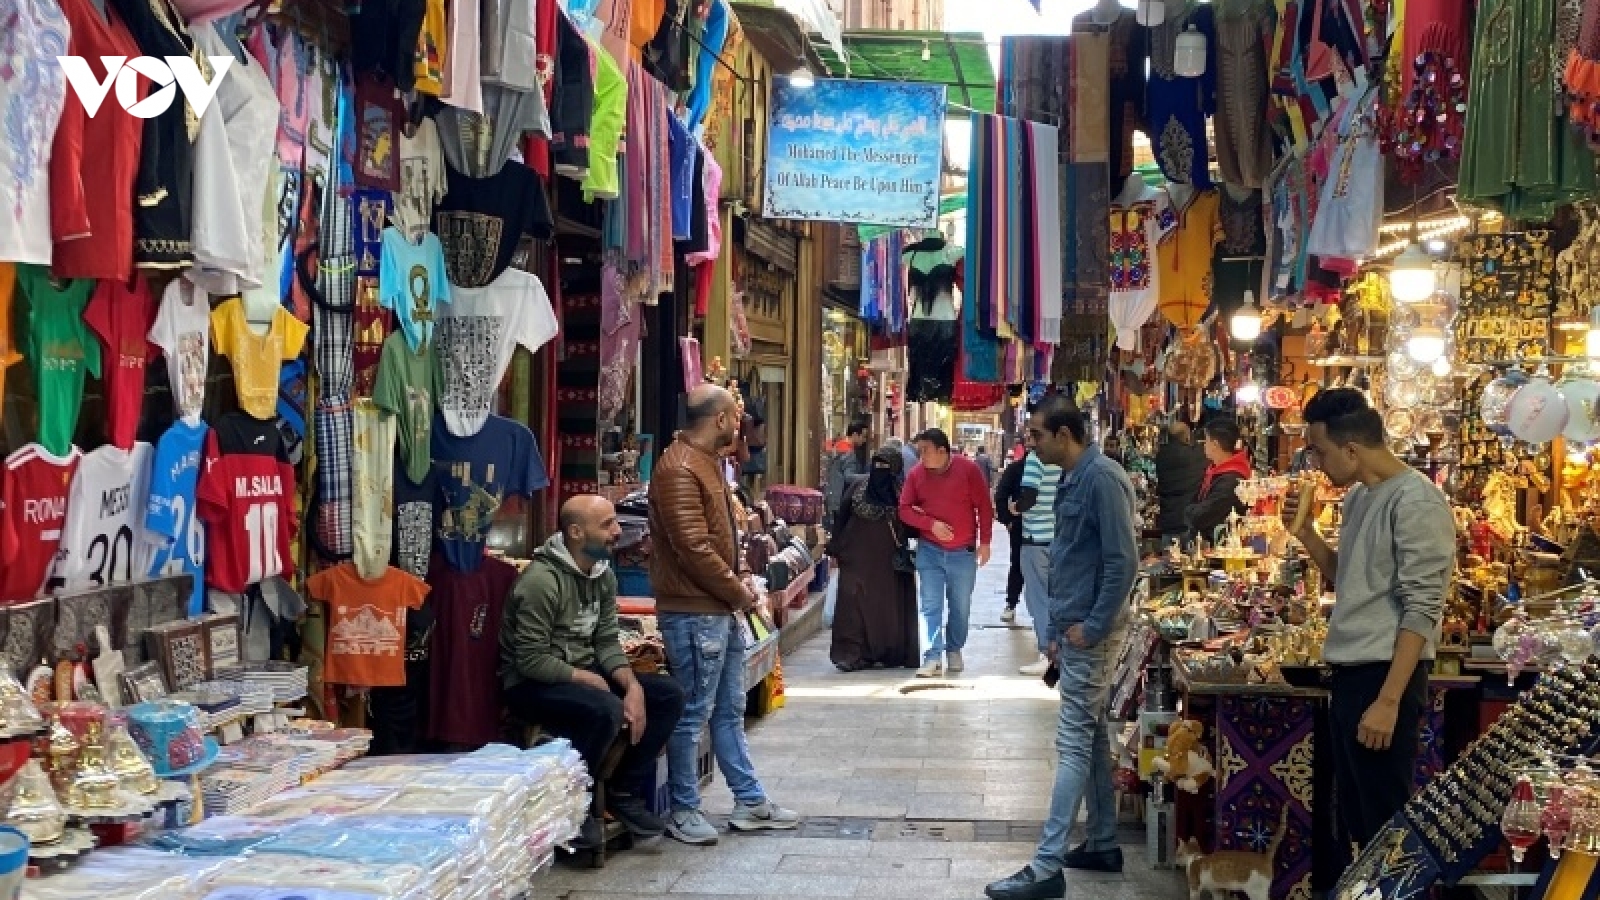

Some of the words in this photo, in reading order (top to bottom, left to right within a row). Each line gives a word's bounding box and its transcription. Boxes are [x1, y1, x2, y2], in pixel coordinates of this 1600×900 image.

[788, 144, 837, 161] Mohamed
[841, 146, 858, 161] The
[862, 147, 918, 167] Messenger
[777, 171, 790, 187] Of
[794, 172, 817, 187] Allah
[821, 173, 850, 190] Peace
[854, 176, 867, 191] Be
[871, 177, 896, 195] Upon
[900, 178, 923, 193] Him
